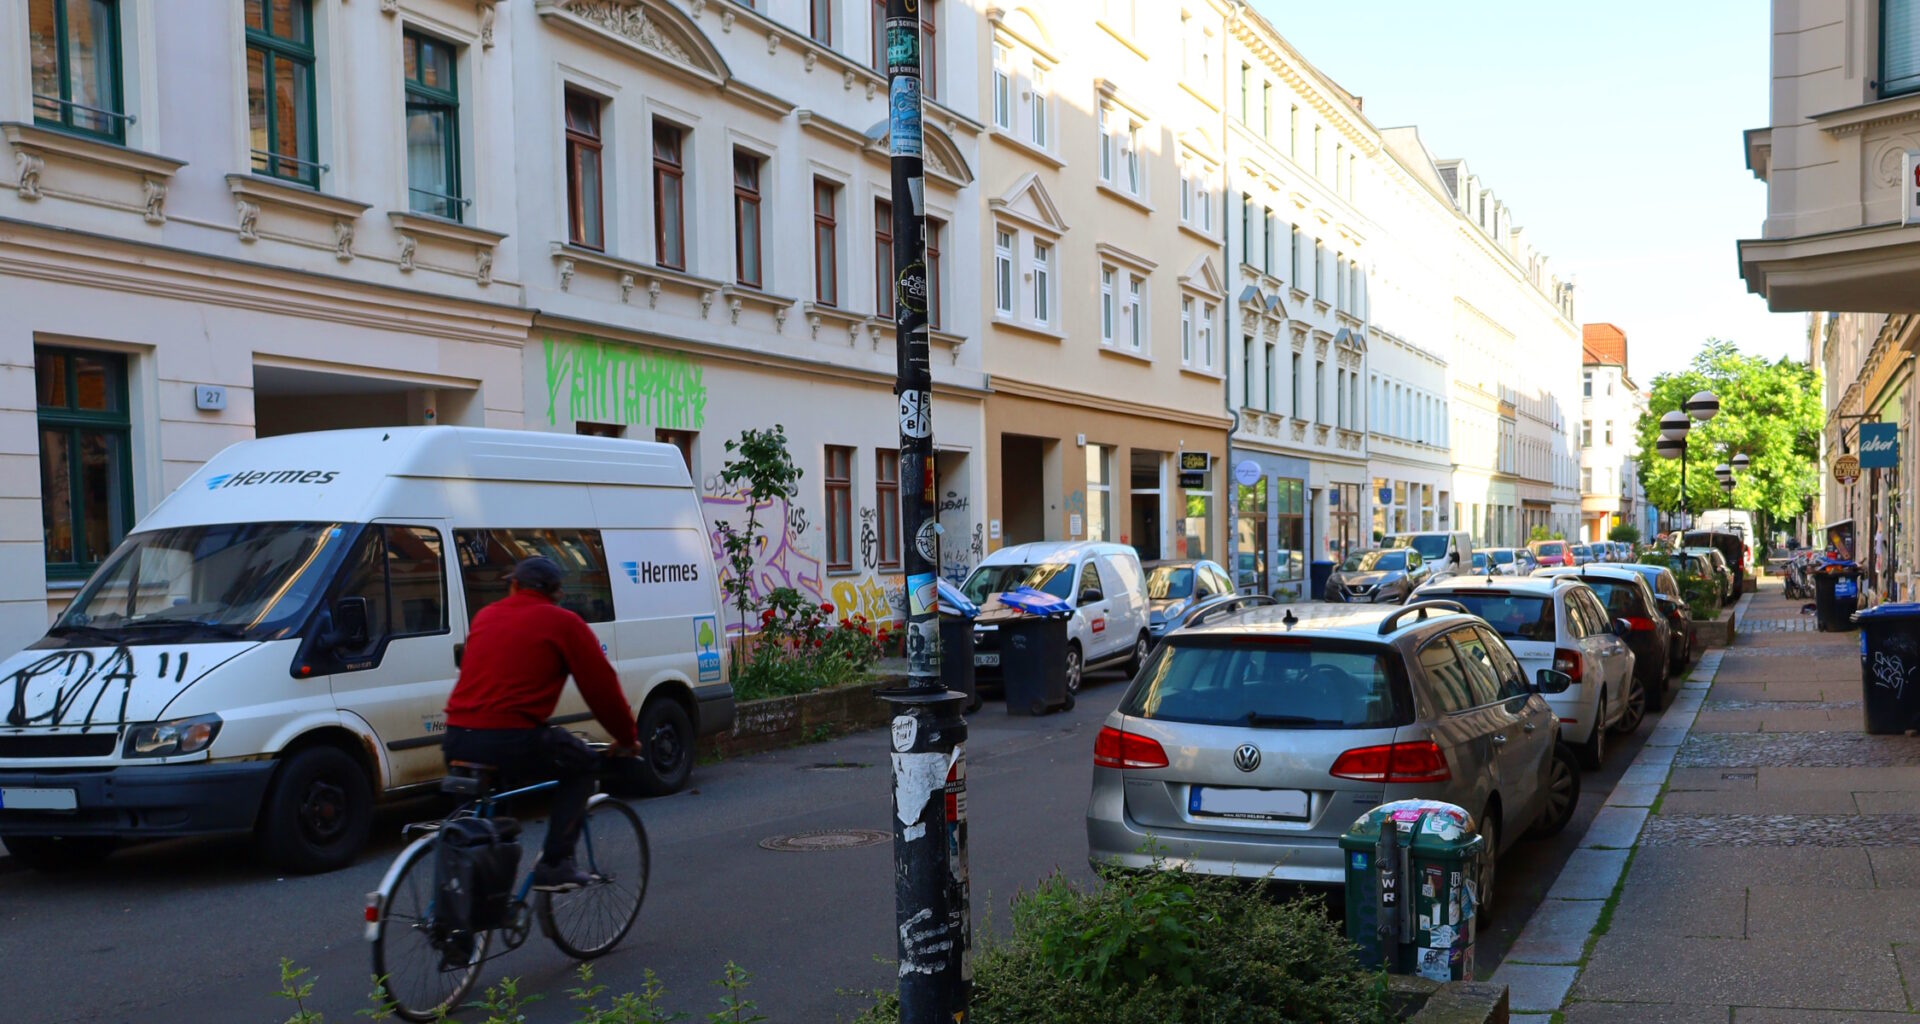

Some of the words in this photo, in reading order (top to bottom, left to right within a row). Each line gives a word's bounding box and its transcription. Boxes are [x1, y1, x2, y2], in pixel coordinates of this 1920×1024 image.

[206, 391, 220, 403] 27
[1860, 434, 1896, 452] ahoi
[223, 470, 340, 488] Hermes
[641, 561, 698, 584] Hermes
